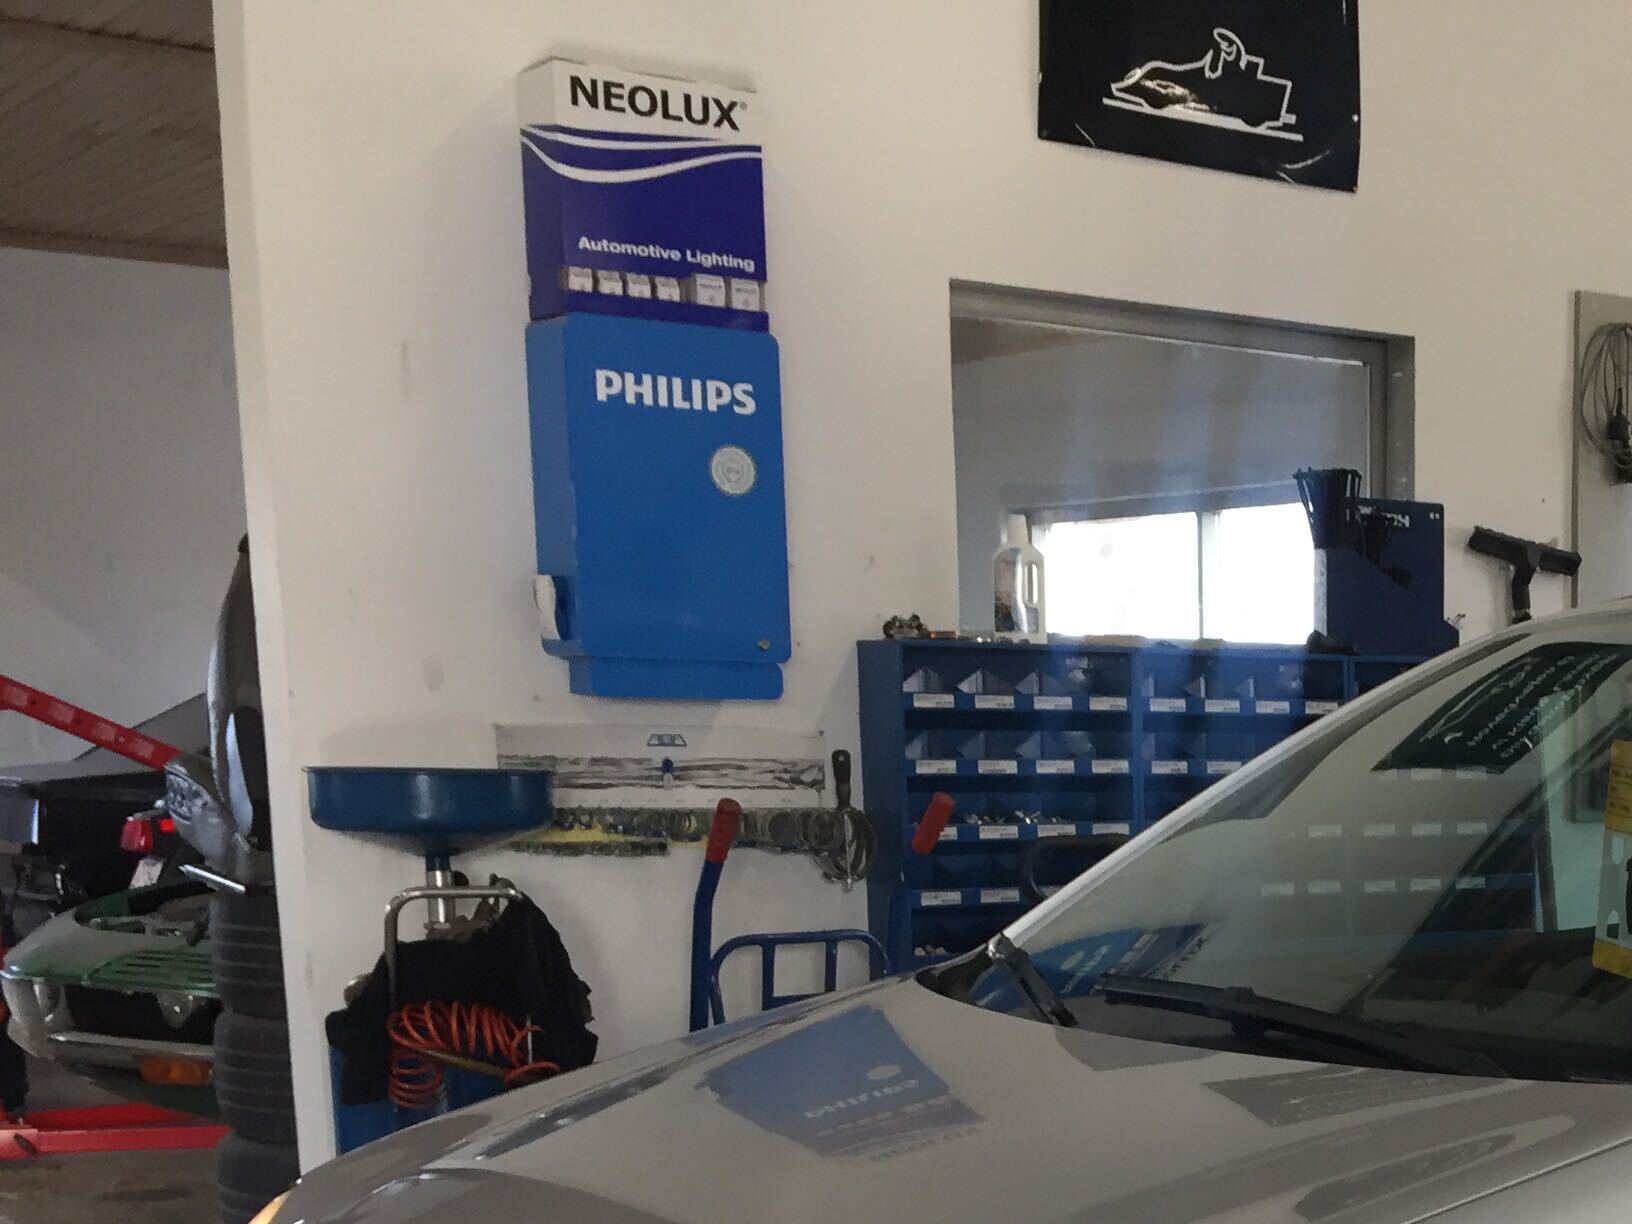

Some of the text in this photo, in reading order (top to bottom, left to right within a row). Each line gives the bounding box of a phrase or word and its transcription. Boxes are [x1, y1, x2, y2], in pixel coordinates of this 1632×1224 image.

[569, 75, 741, 132] NEOLUX
[577, 235, 755, 273] Automotive Lighting
[594, 368, 757, 416] PHILIPS
